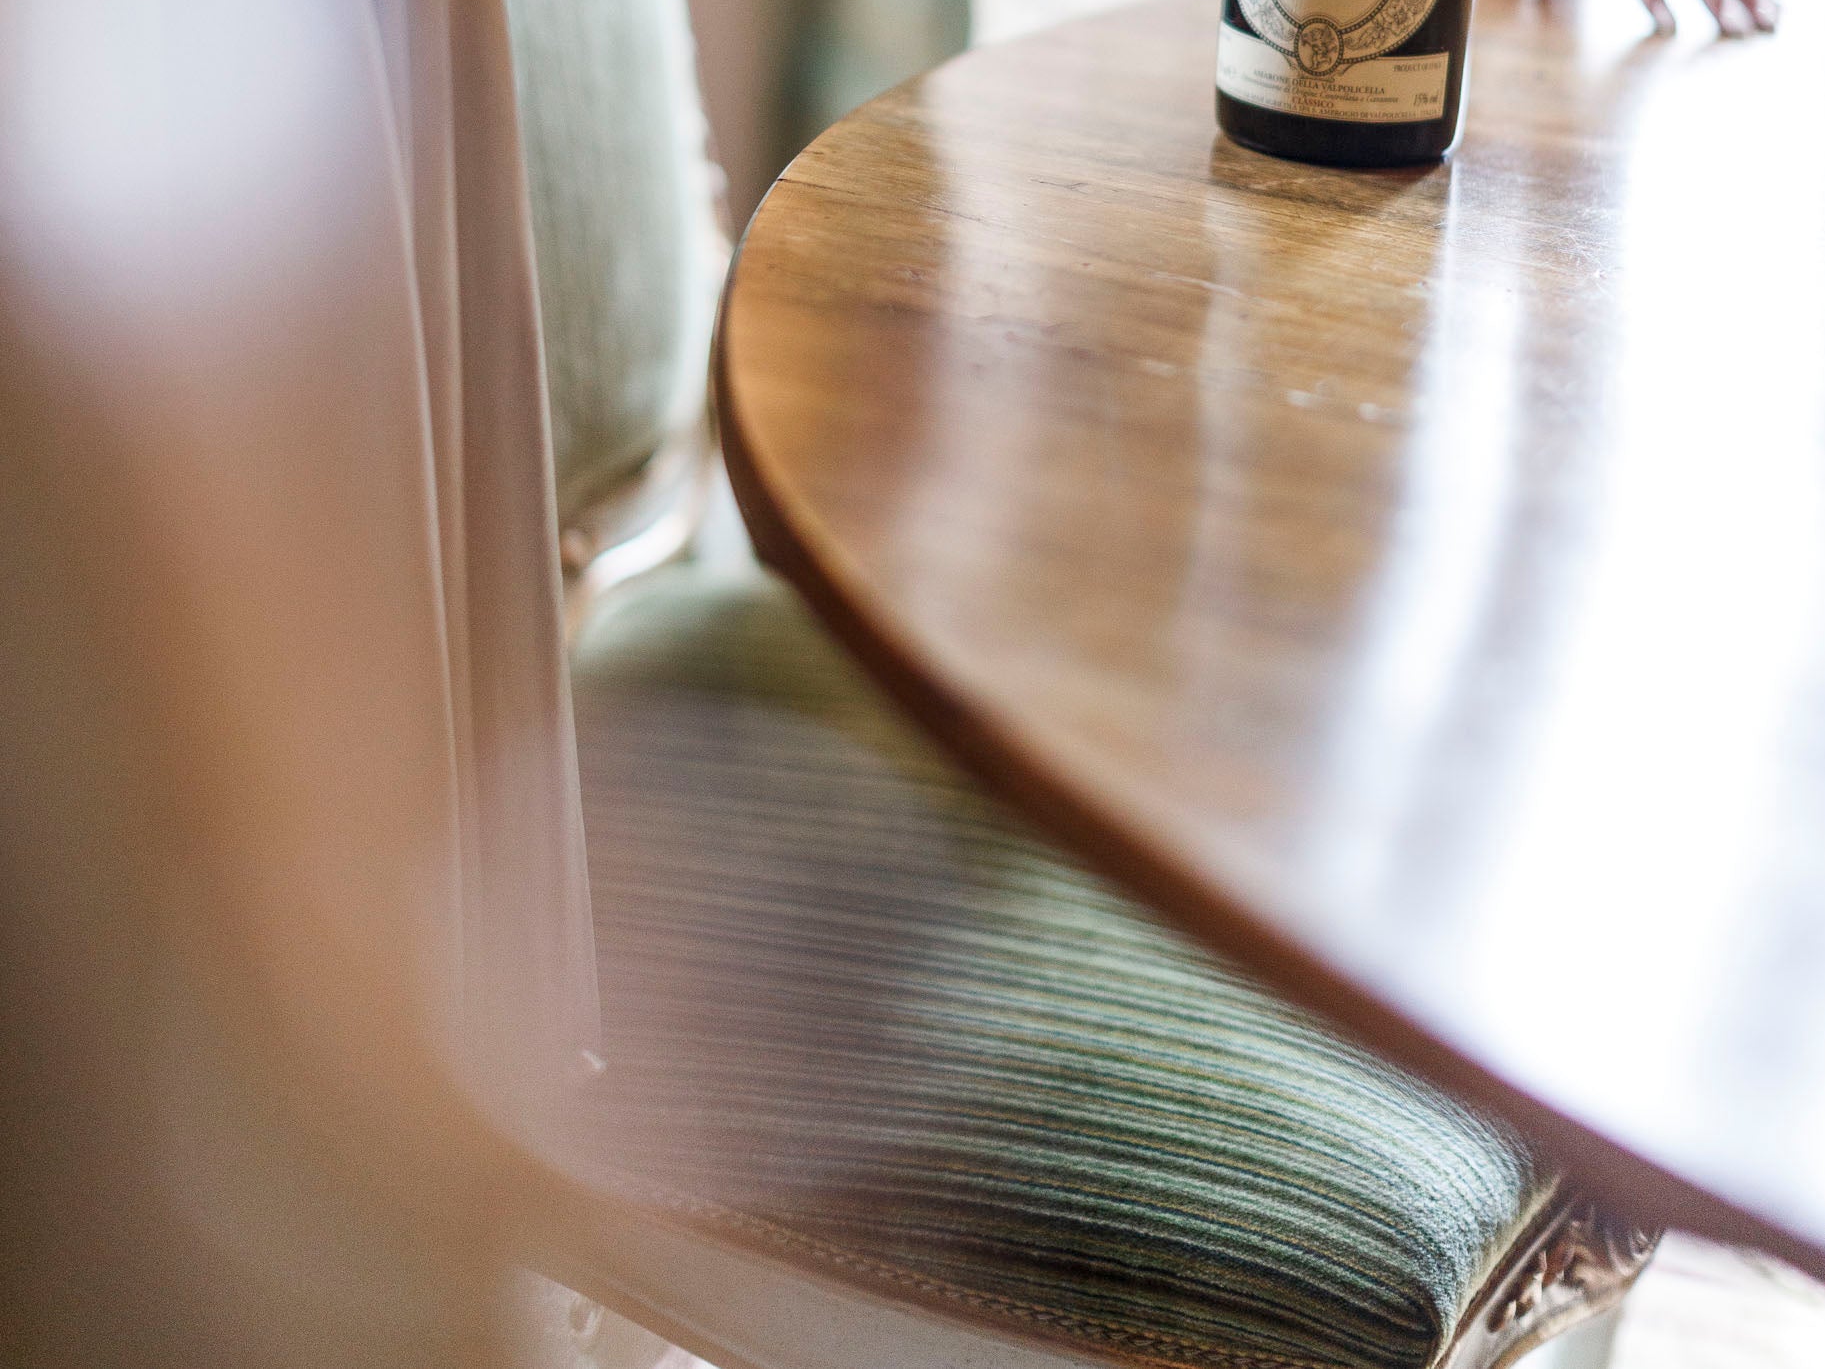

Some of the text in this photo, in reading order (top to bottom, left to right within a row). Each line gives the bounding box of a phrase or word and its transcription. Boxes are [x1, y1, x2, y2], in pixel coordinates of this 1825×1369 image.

[1292, 78, 1319, 89] DELLA
[1321, 83, 1385, 94] VALPOLICELLA
[1292, 96, 1335, 108] CLASSICO
